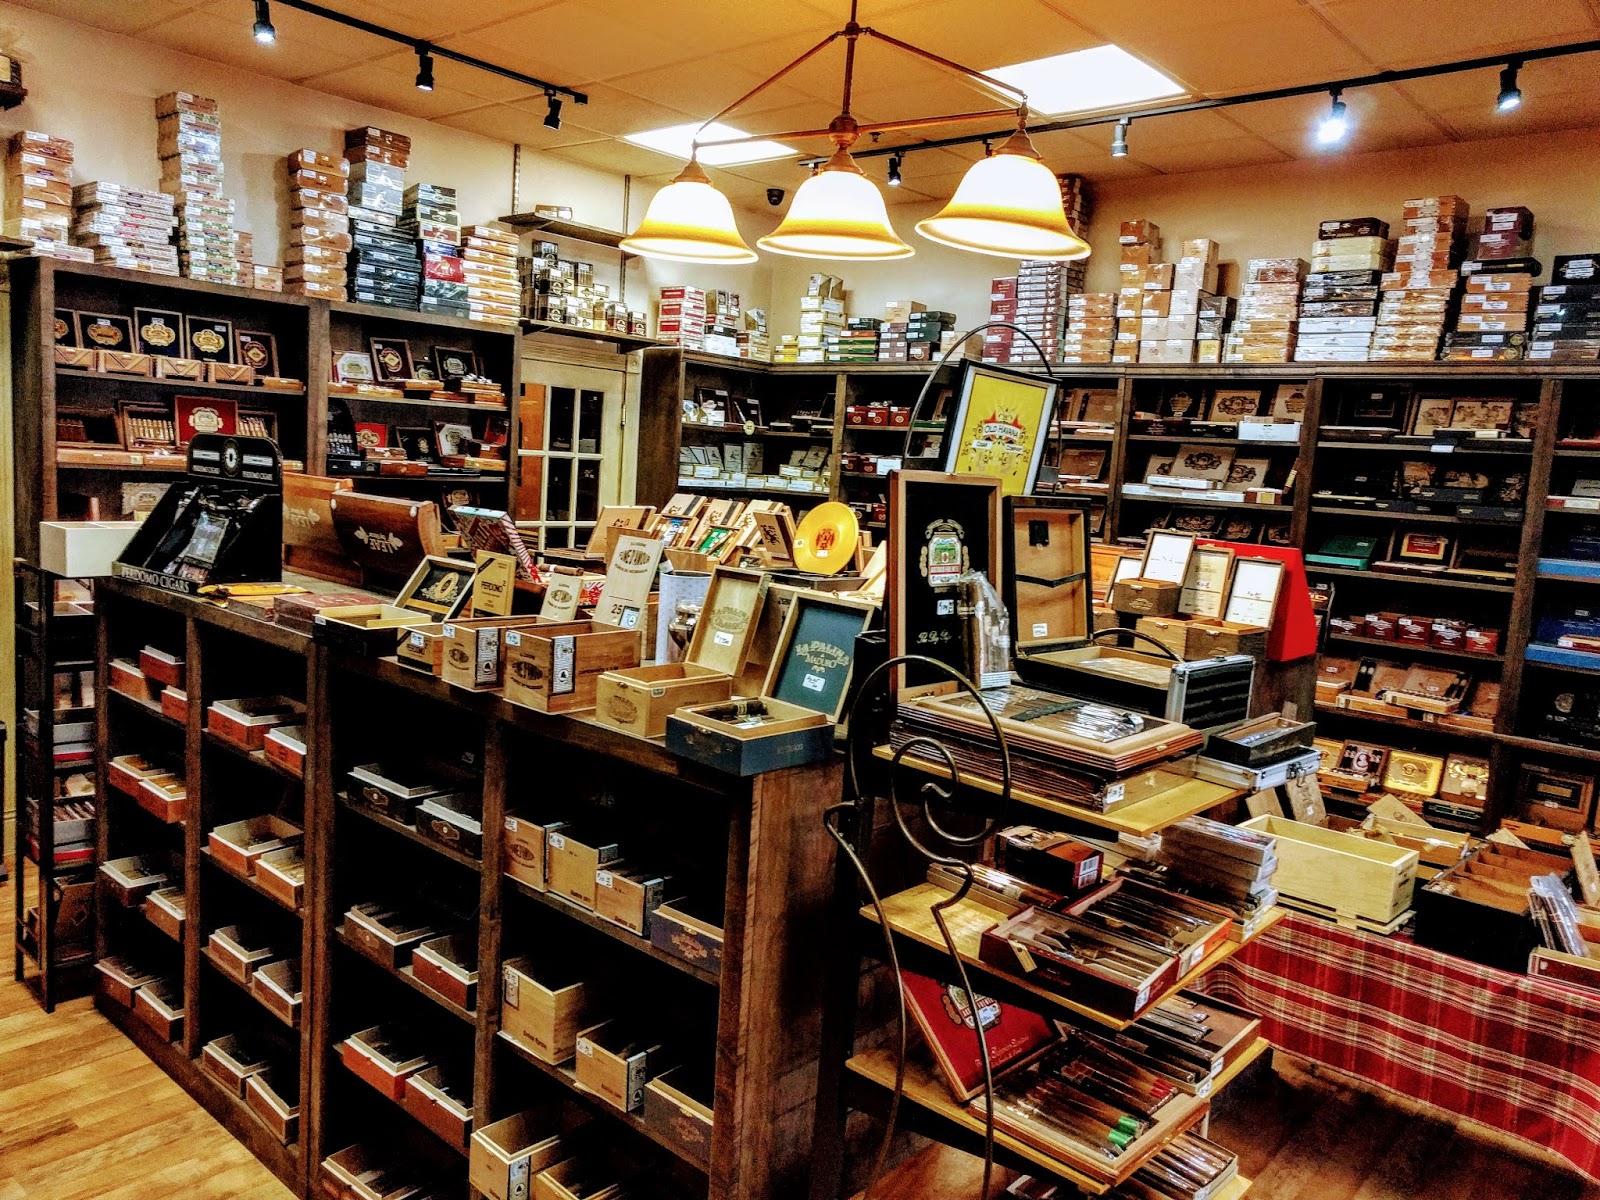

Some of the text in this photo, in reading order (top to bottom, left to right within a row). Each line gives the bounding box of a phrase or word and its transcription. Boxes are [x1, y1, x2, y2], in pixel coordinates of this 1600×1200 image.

[984, 424, 999, 434] OLD
[121, 567, 190, 593] PERDOMO CIGARS
[611, 603, 623, 615] 25
[804, 653, 838, 669] MADURO
